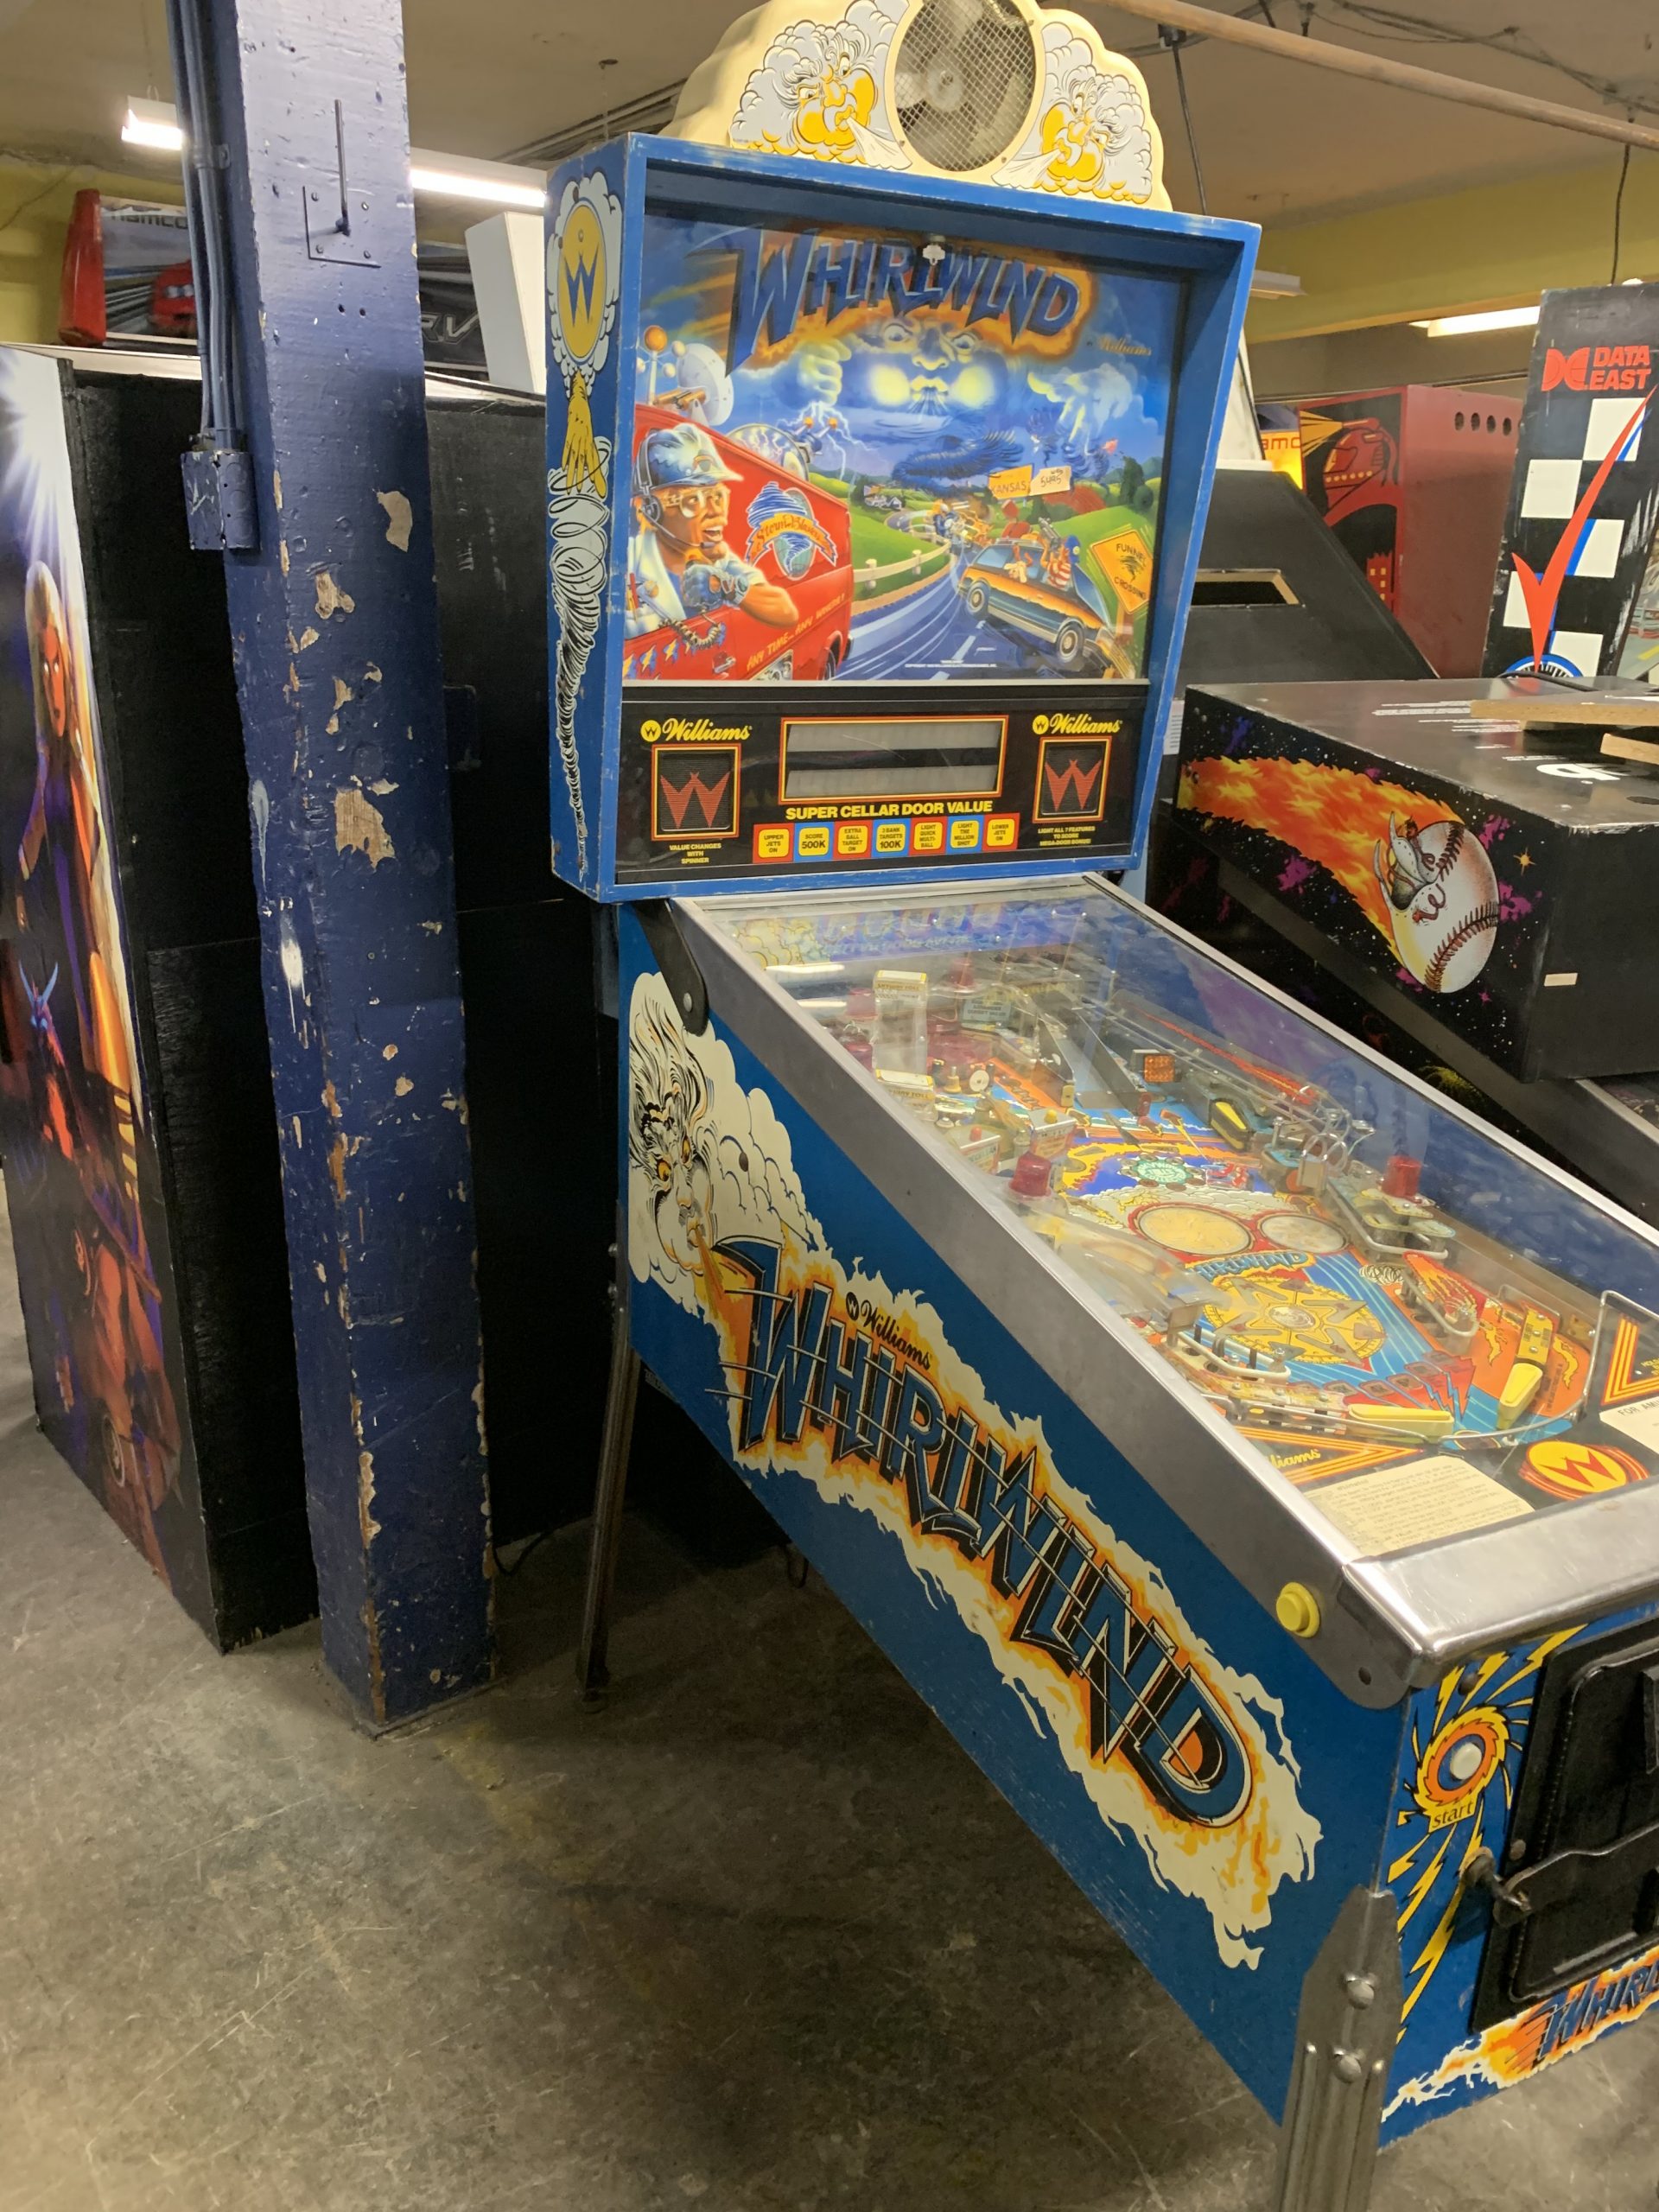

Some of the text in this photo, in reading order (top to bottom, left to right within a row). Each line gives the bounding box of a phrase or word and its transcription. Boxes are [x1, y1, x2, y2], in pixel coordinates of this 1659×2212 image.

[710, 228, 1080, 378] WHIRLWIND
[1592, 345, 1650, 367] DATA
[1589, 368, 1652, 391] EAST
[1116, 543, 1147, 568] FUNNEL
[1114, 576, 1147, 600] CROSSING
[662, 717, 751, 741] Williams
[1049, 713, 1121, 734] Williams
[785, 800, 994, 820] SUPER CELLAR DOOR VALUE
[801, 840, 827, 849] 500K
[879, 840, 902, 849] 100K
[860, 1299, 931, 1370] Williams
[1617, 1405, 1639, 1416] FOR
[1269, 1449, 1321, 1469] liams
[712, 1235, 1253, 1828] WHIRLWIND
[1432, 1801, 1474, 1828] start
